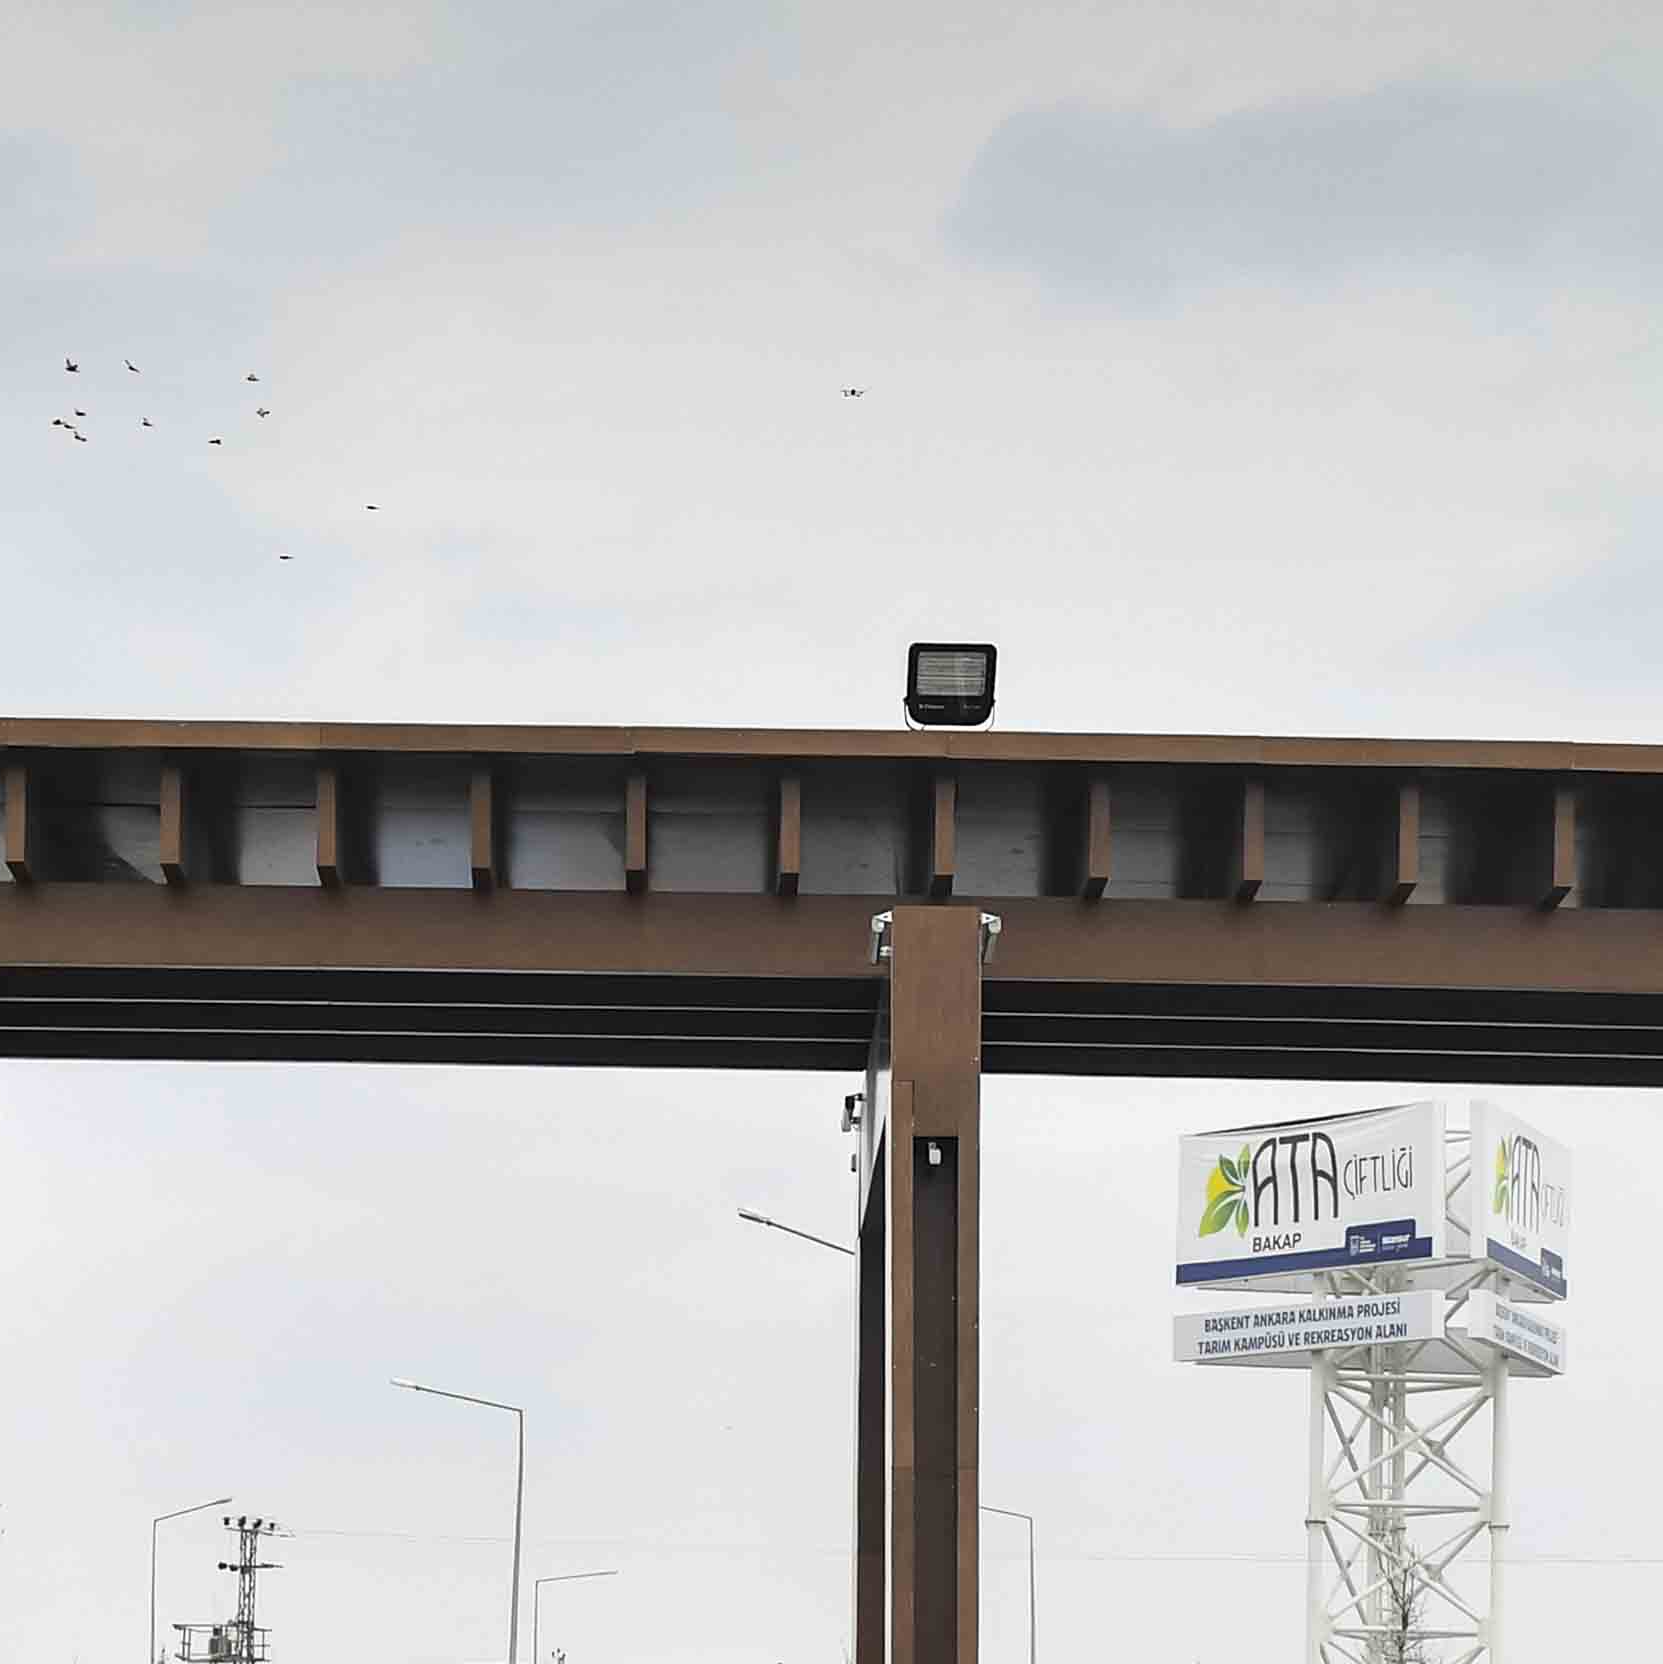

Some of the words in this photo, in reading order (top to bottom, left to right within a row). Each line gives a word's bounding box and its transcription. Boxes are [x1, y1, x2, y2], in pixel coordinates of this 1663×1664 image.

[1251, 1131, 1339, 1228] ATA
[1343, 1146, 1414, 1201] ÇİFTLİĞİ
[1252, 1232, 1302, 1254] BAKAP
[1204, 1316, 1251, 1333] BAŞKENT
[1253, 1311, 1296, 1329] ANKARA
[1298, 1305, 1354, 1324] KALKINMA
[1356, 1297, 1401, 1318] PROJESİ
[1198, 1340, 1232, 1356] TARIM
[1233, 1331, 1285, 1352] KAMPÜSÜ
[1288, 1333, 1301, 1347] VE
[1303, 1326, 1373, 1346] REKREASYON
[1375, 1323, 1408, 1339] ALANI
